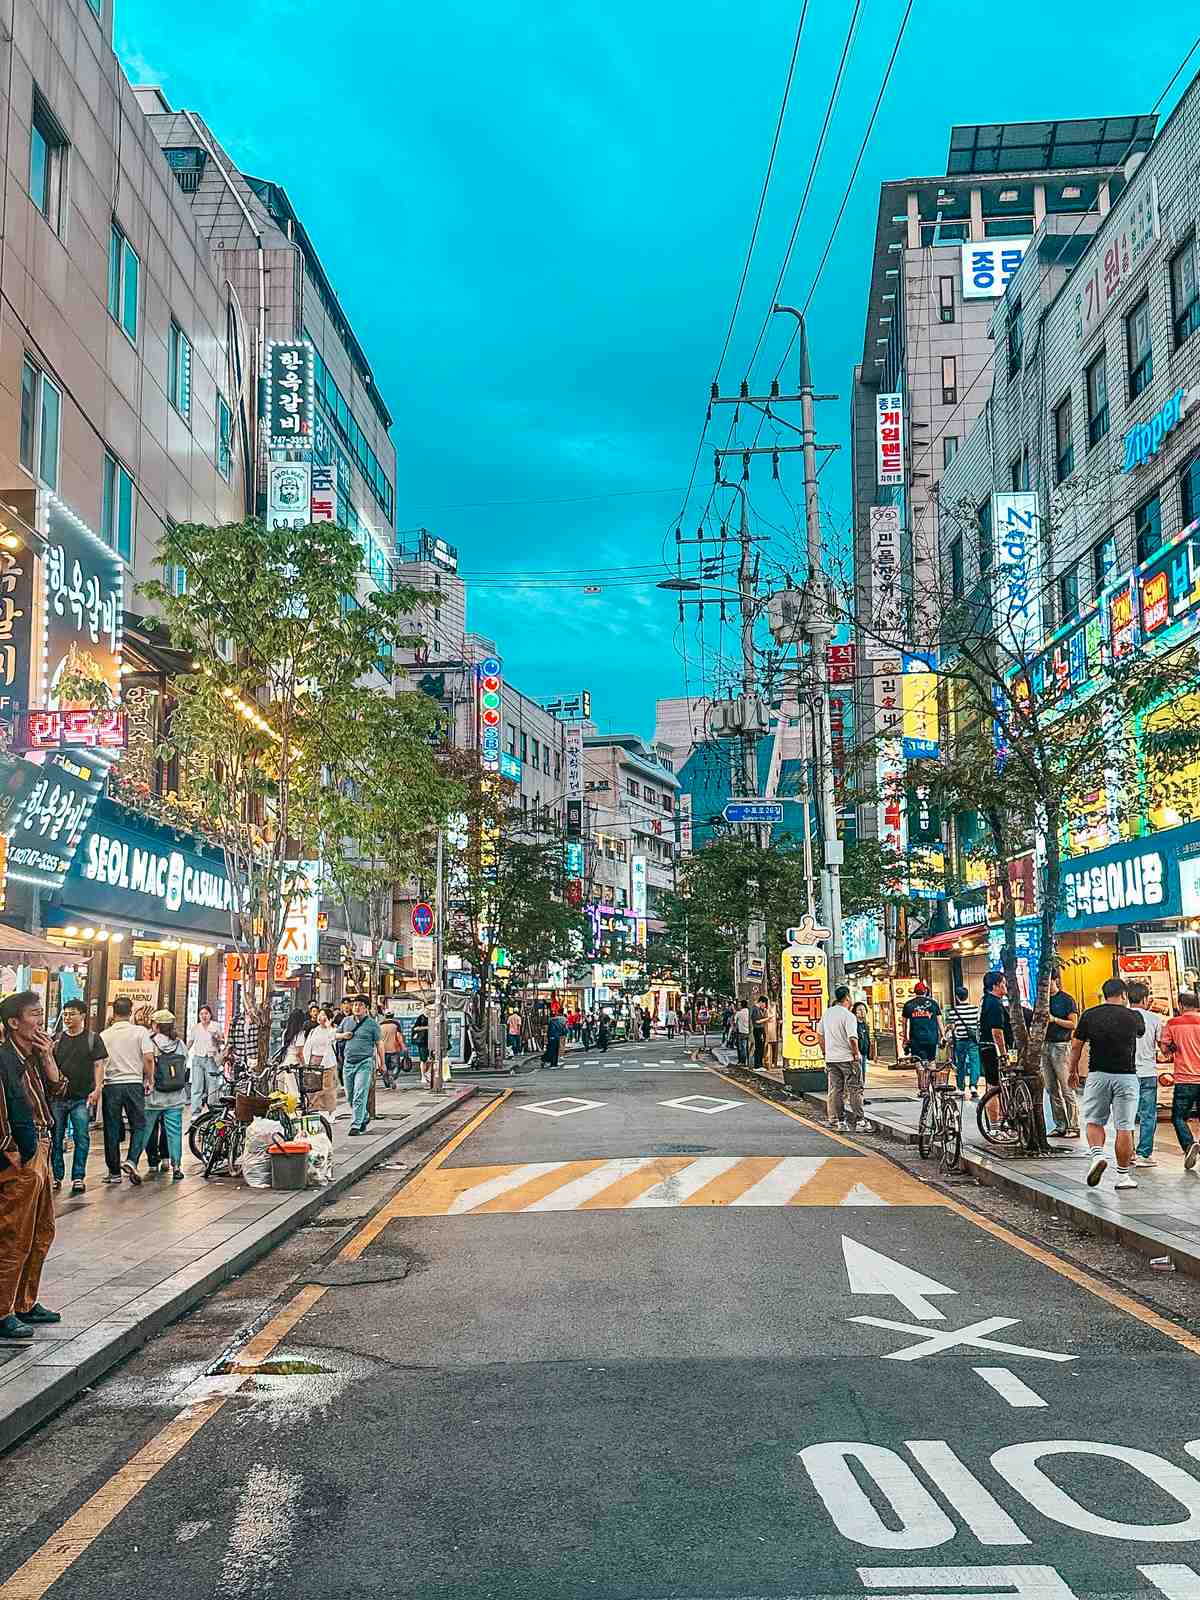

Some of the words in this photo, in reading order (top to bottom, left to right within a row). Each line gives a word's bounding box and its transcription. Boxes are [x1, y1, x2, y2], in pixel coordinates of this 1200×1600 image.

[279, 351, 303, 433] 한옥갈비
[880, 411, 901, 473] 게임랜드
[1121, 387, 1184, 472] Zipper
[50, 545, 117, 654] 한옥갈비
[23, 779, 87, 844] 한옥갈비
[87, 833, 129, 888] SEOL
[130, 848, 168, 897] MAC
